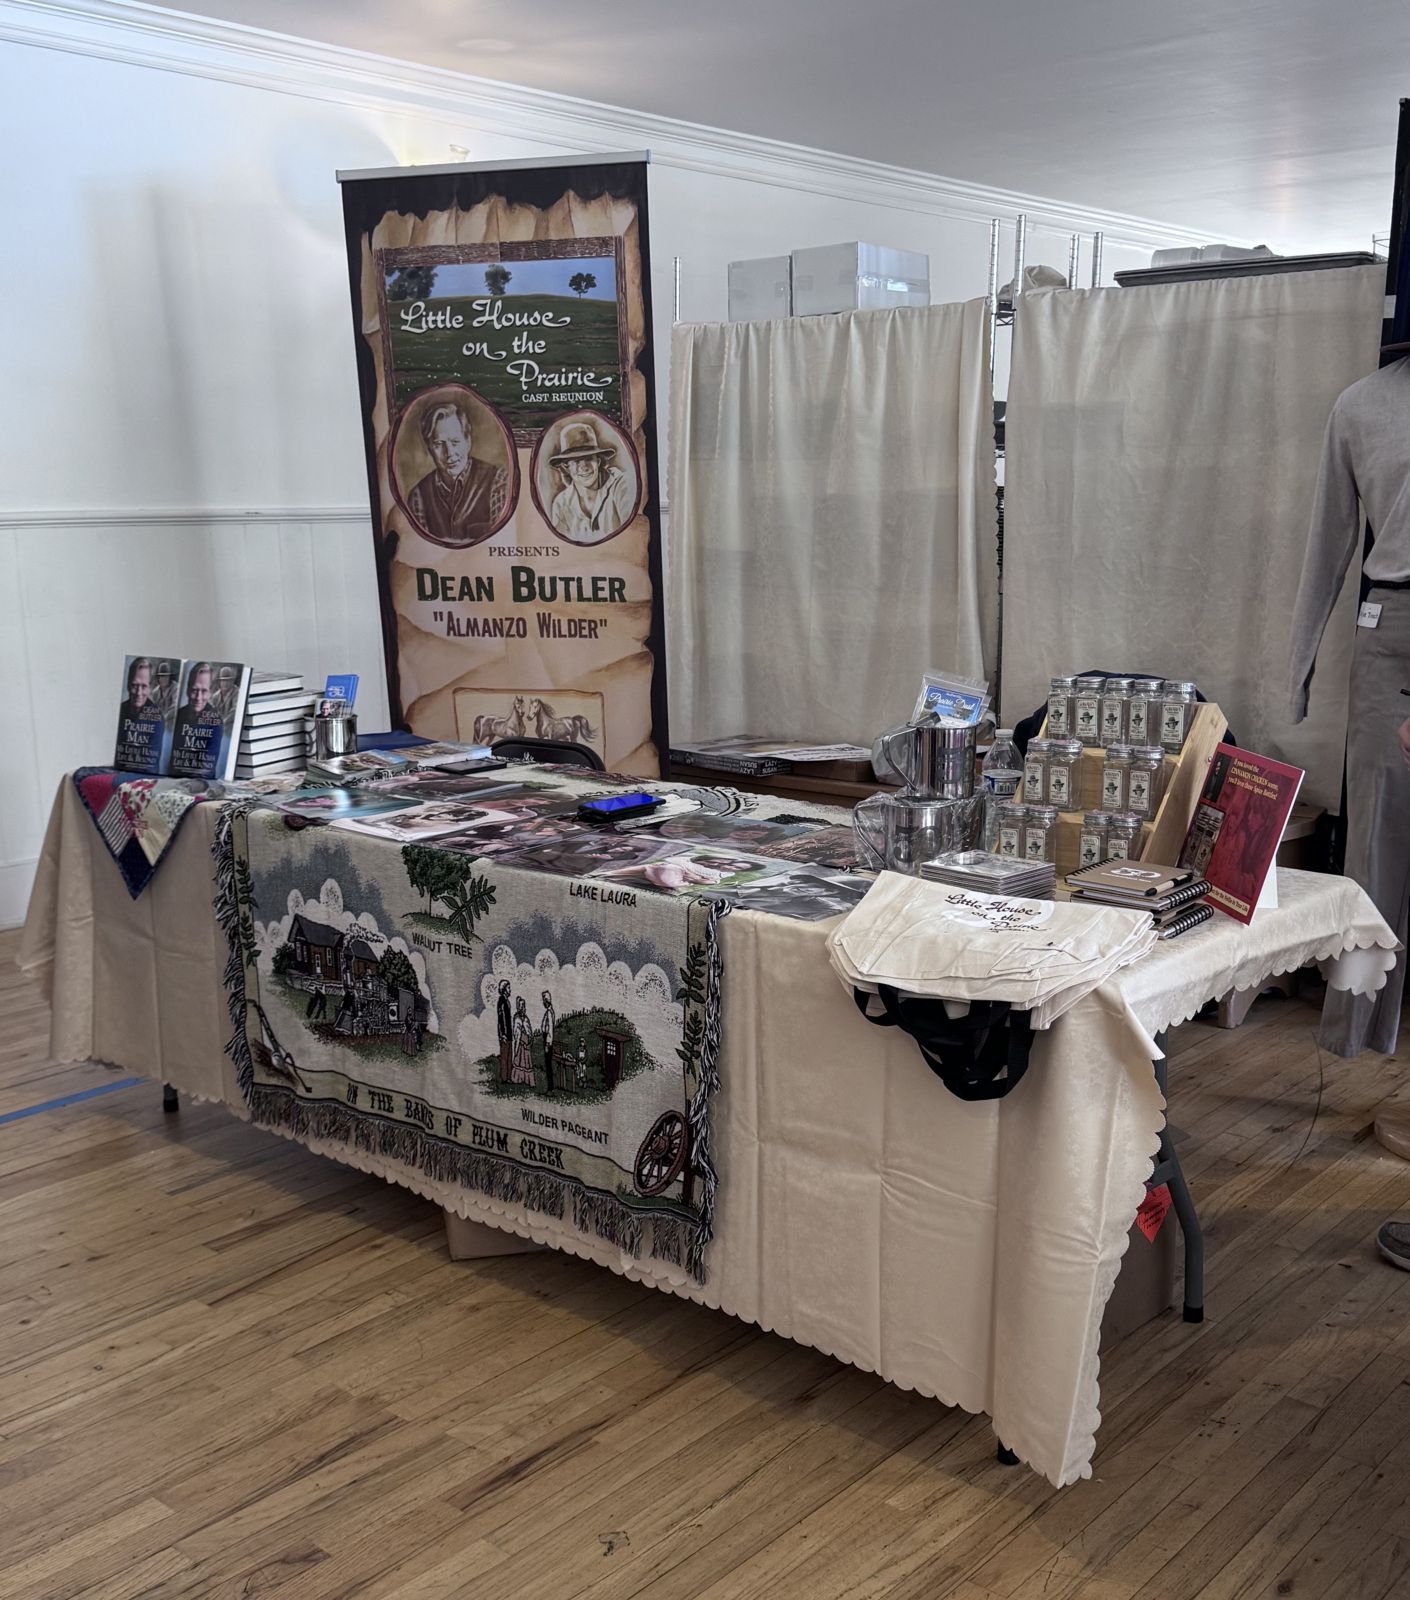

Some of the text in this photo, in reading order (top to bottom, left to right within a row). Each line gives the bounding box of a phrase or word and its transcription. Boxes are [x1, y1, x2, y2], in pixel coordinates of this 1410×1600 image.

[400, 300, 571, 333] Little House
[462, 331, 547, 360] on the
[506, 359, 612, 391] Prairie
[522, 391, 604, 403] CAST REUNION
[488, 546, 560, 557] PRESENTS
[416, 565, 627, 603] DEAN BUTLER
[433, 611, 608, 640] "ALMANZO WILDER"
[124, 719, 156, 733] PRAIRIE
[181, 724, 214, 738] PRAIRIE
[198, 718, 222, 726] BUTLER
[127, 731, 150, 744] MAN
[184, 736, 208, 749] MAN
[569, 882, 637, 907] LAKE LAURA
[944, 894, 1041, 916] Little House
[446, 942, 473, 959] TREE
[368, 1089, 394, 1113] THE
[445, 1115, 462, 1137] OF
[472, 1123, 509, 1153] PLUM
[520, 1137, 565, 1170] CREEK
[521, 1108, 609, 1145] WILDER PAGEANT
